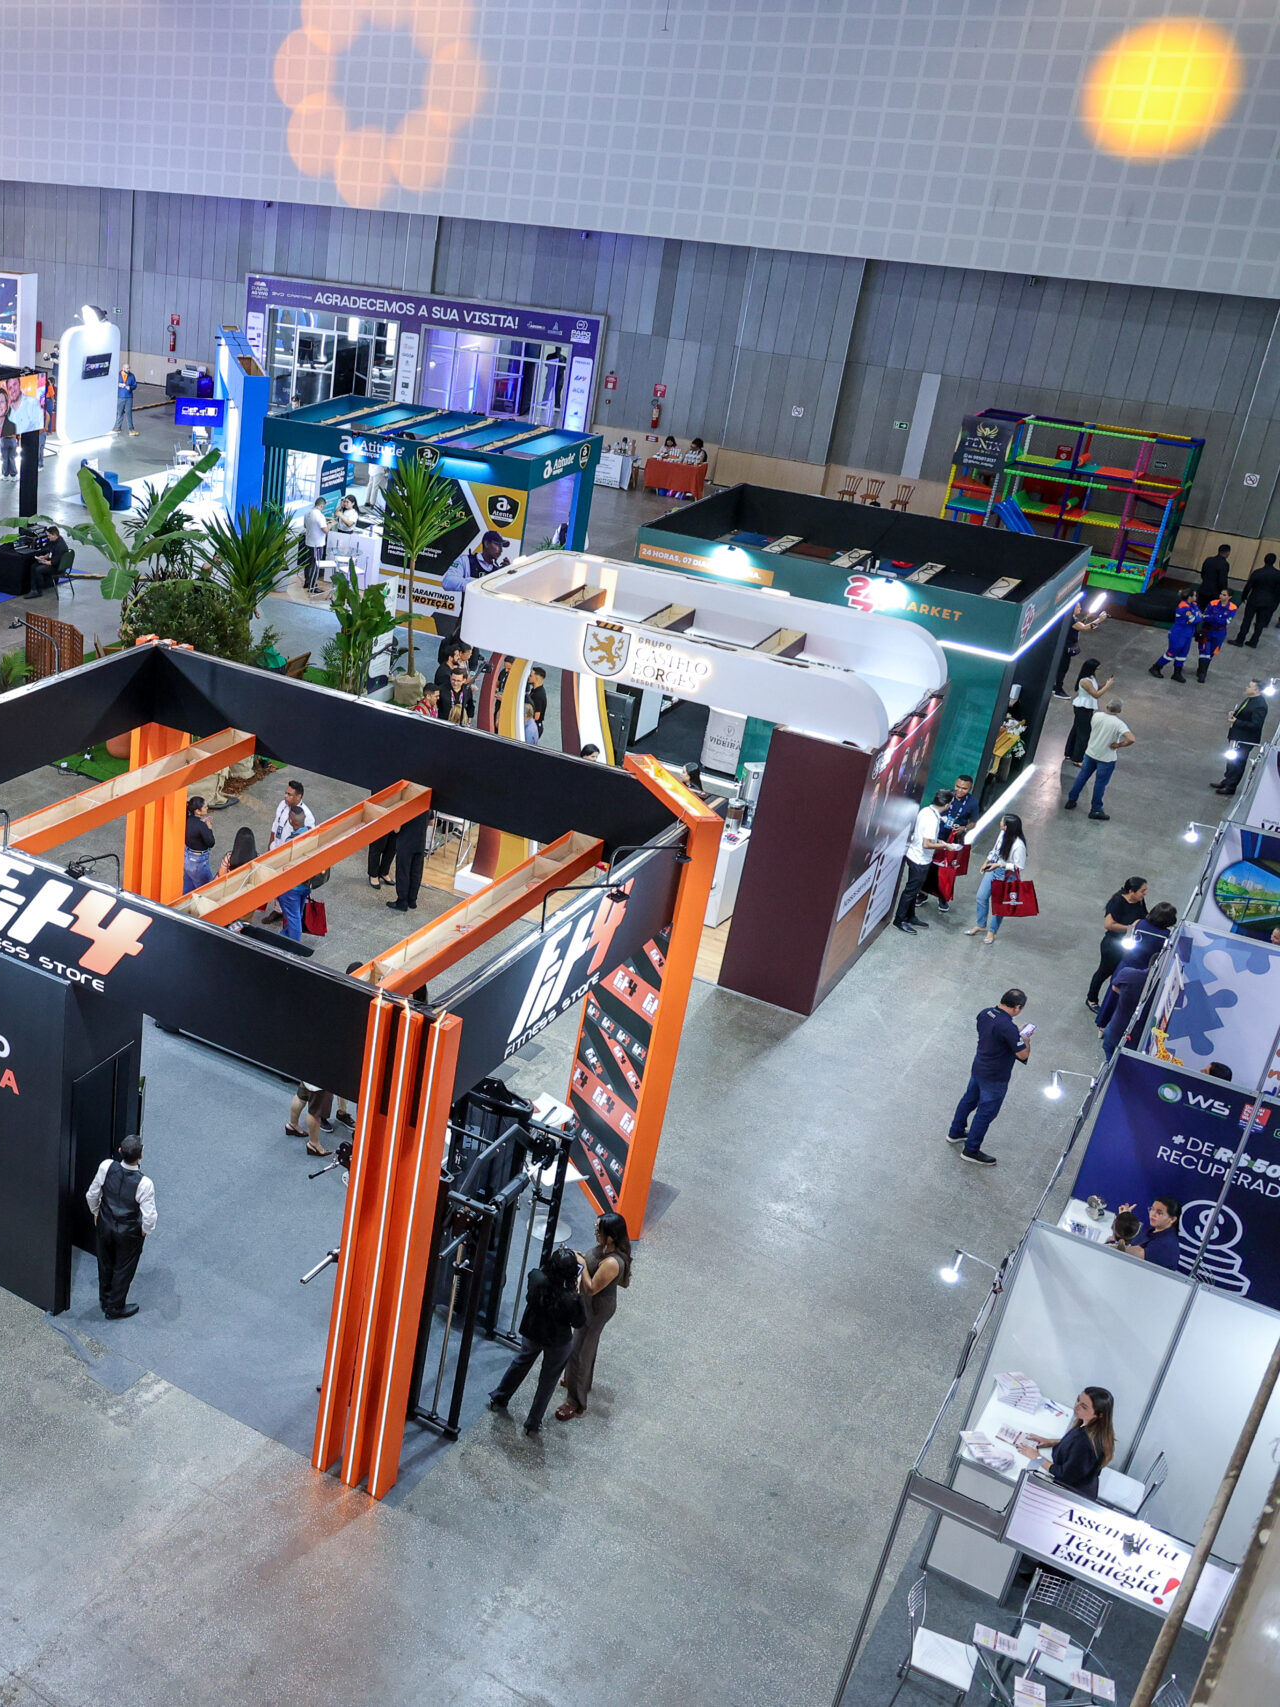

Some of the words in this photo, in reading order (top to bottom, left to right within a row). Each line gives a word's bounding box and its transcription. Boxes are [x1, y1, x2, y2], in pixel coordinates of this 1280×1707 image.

[314, 291, 415, 316] AGRADECEMOS
[418, 304, 428, 317] A
[431, 306, 460, 322] SUA
[463, 310, 519, 329] VISITA!
[641, 547, 653, 557] 24
[638, 636, 672, 651] GRUPO
[38, 956, 105, 993] STORE
[504, 1008, 557, 1060] FITNESS
[562, 971, 601, 1011] STORE
[1187, 1091, 1230, 1116] WS
[1186, 1137, 1215, 1157] DE
[1058, 1508, 1180, 1562] Assemleia
